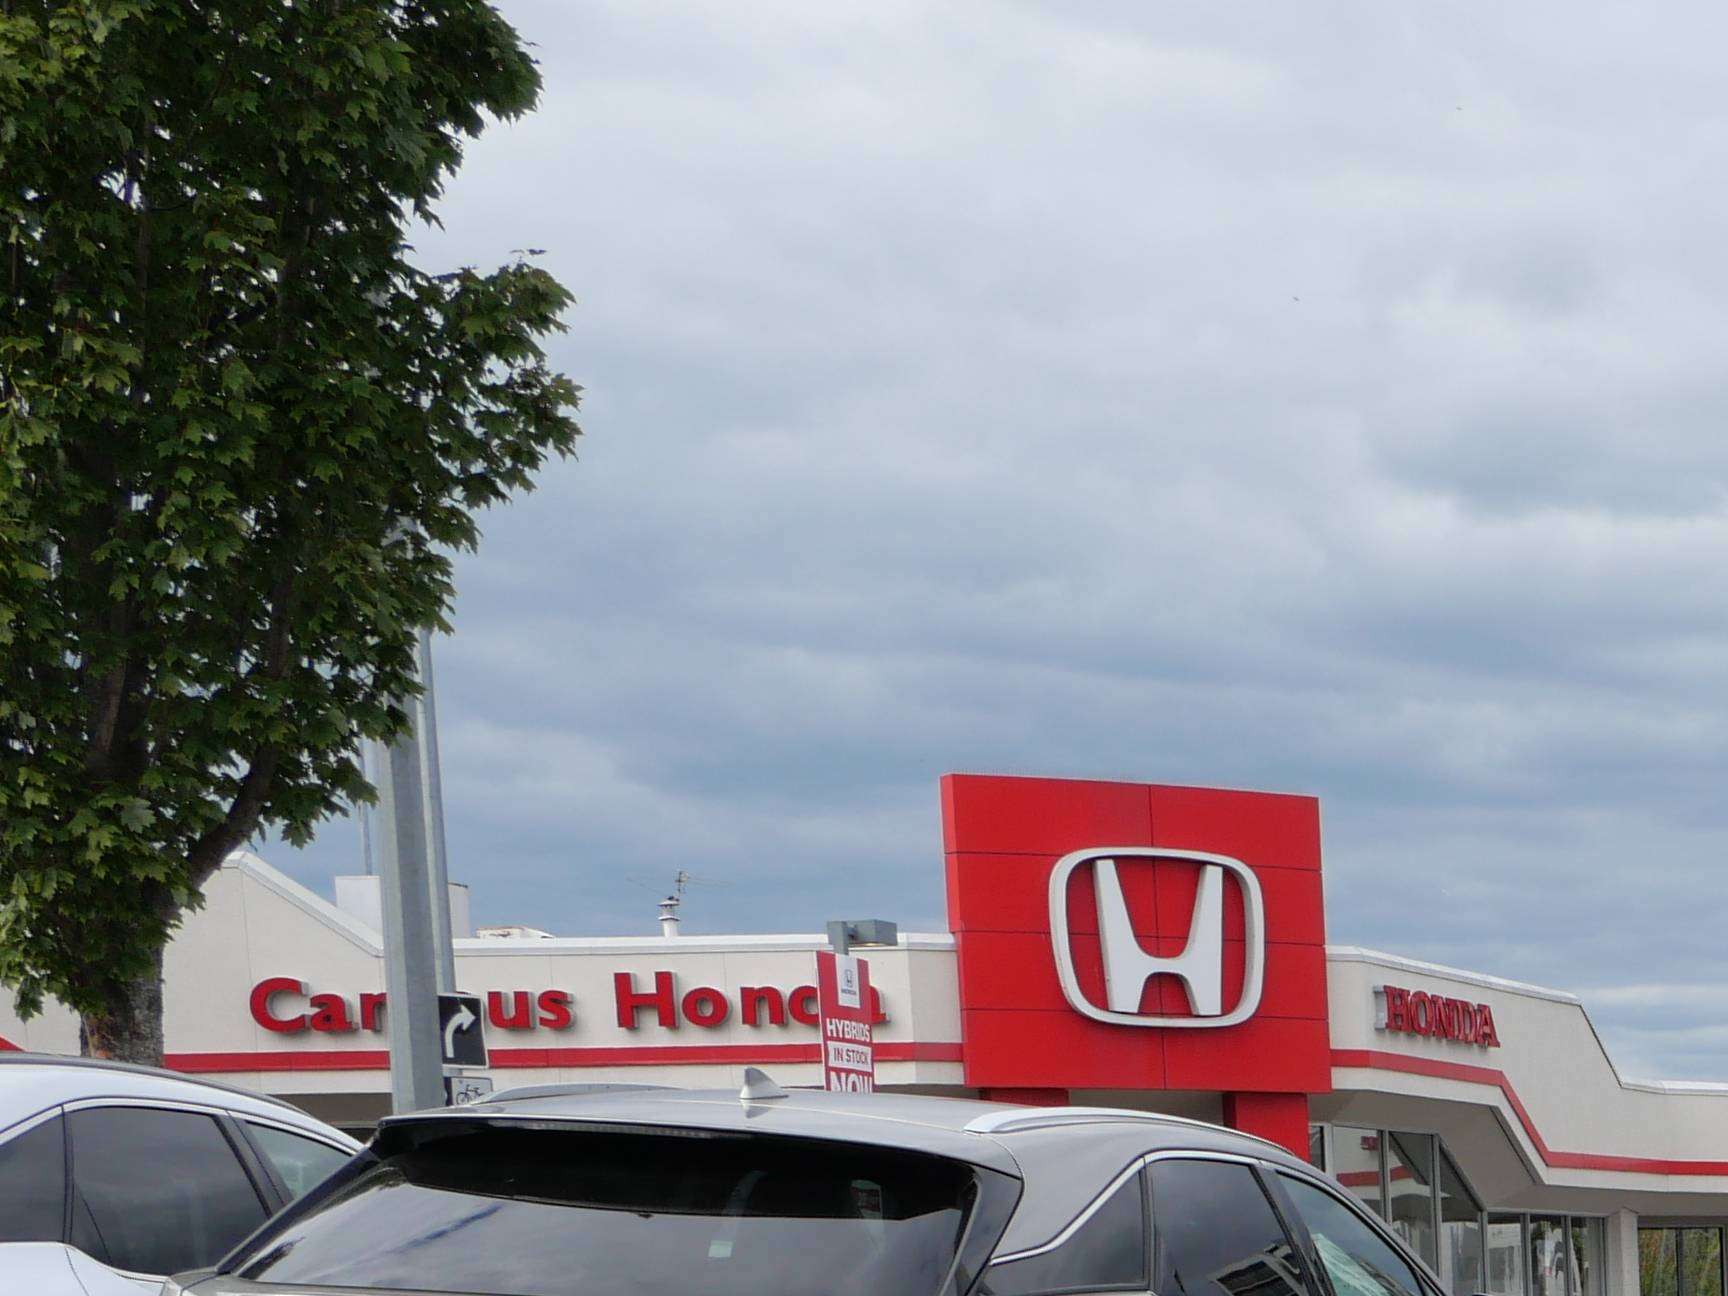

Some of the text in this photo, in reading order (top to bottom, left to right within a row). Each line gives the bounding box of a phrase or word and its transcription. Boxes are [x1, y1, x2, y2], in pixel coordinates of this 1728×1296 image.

[250, 976, 576, 1034] Caus
[1380, 985, 1501, 1048] HONDA
[826, 1018, 871, 1042] HYBRIDS
[833, 1047, 869, 1066] IN STOCK
